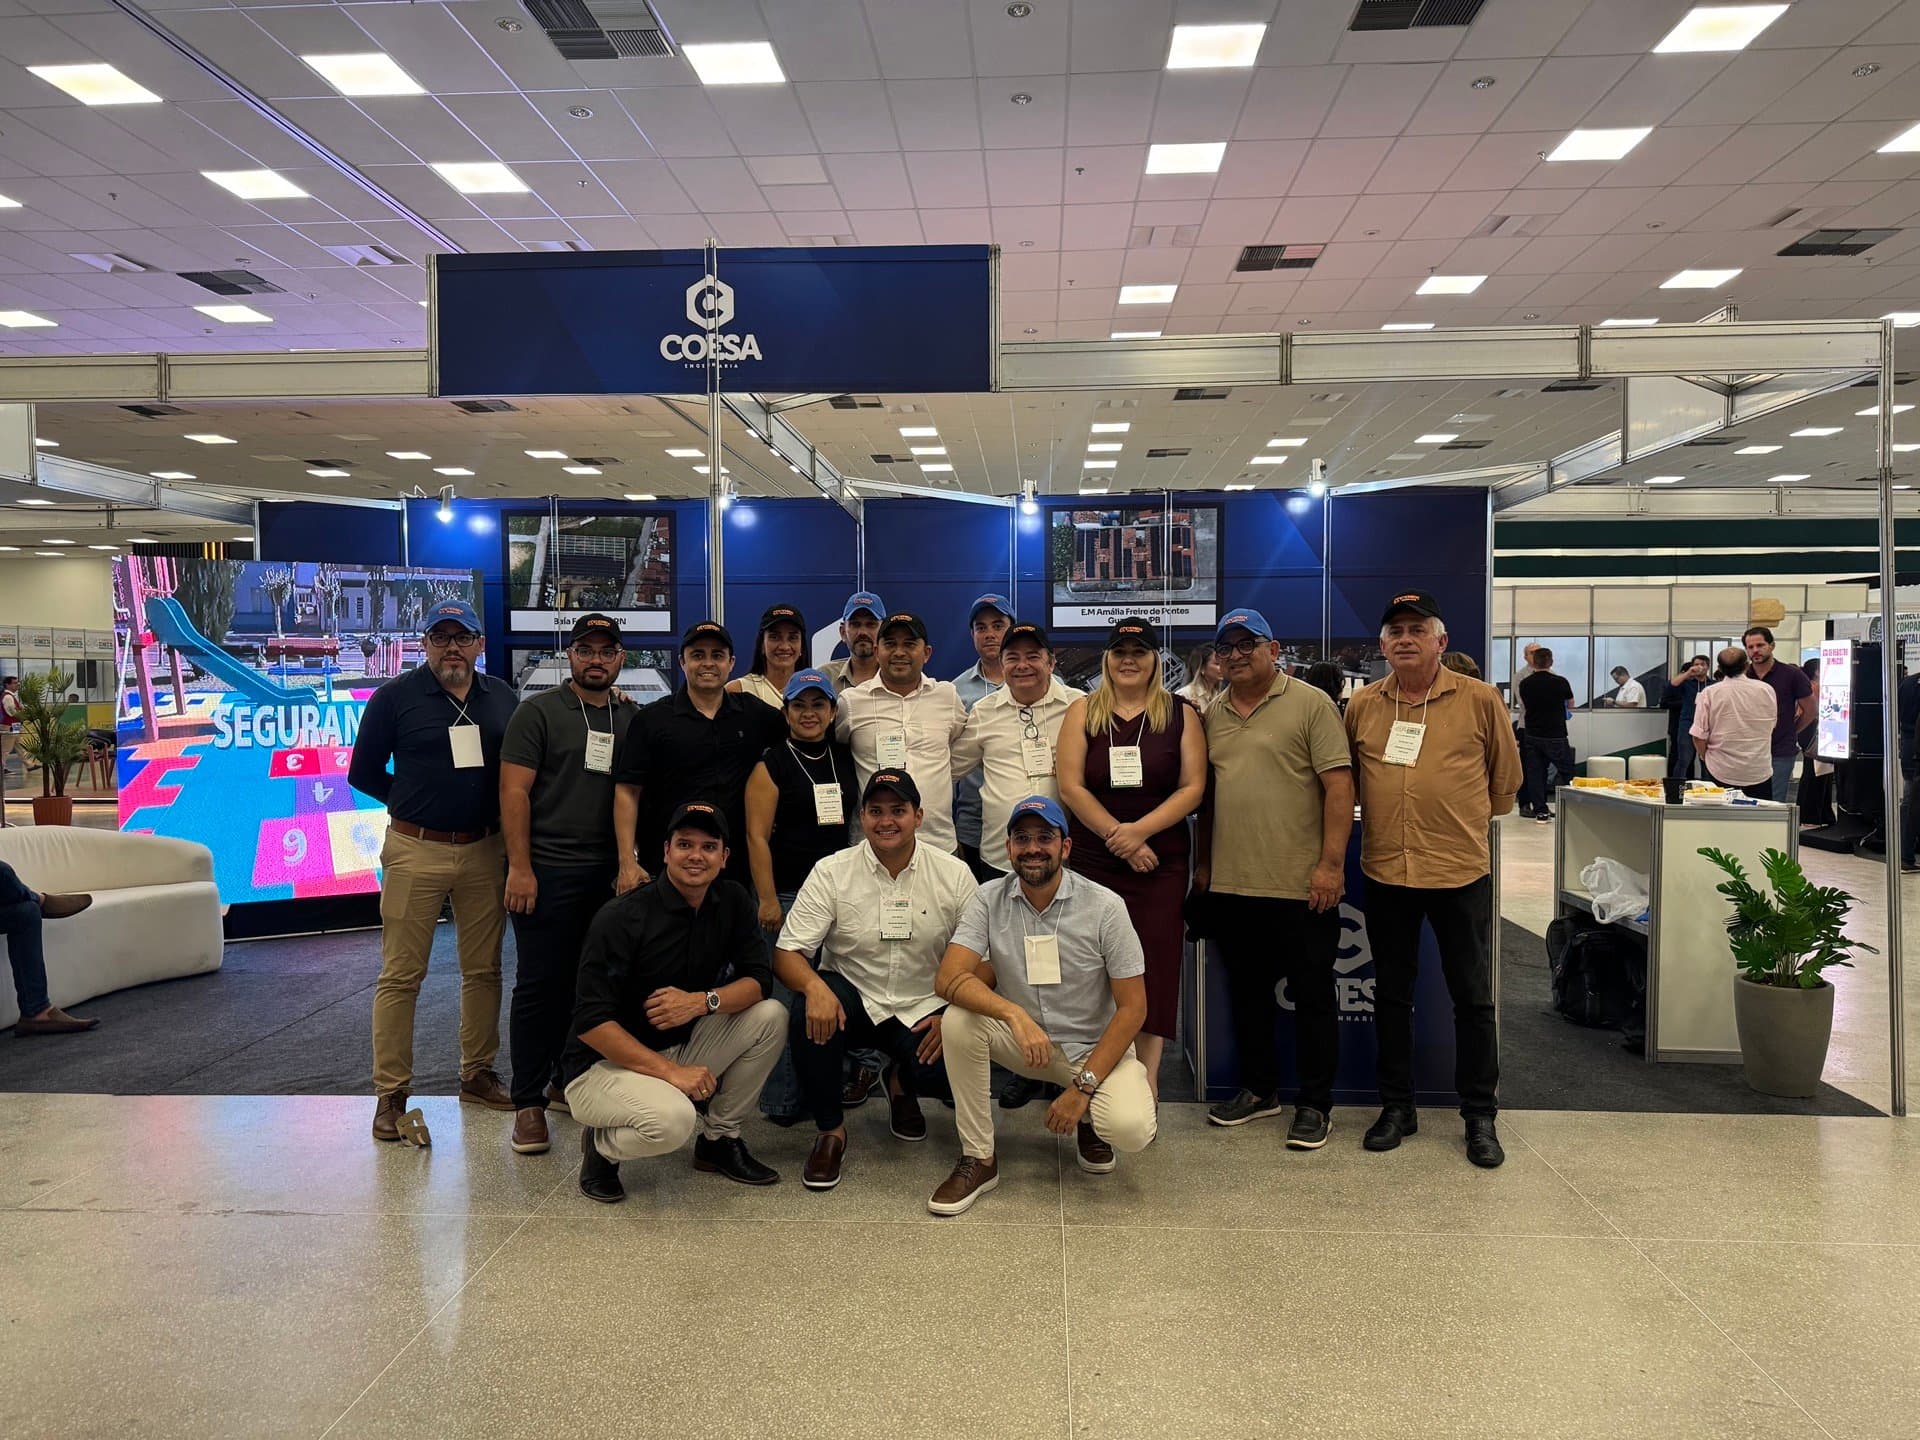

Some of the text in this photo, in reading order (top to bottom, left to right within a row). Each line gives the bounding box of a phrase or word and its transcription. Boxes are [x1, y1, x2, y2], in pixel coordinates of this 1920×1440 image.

[659, 333, 763, 361] COESA
[1096, 607, 1125, 616] Amália
[1149, 607, 1160, 615] de
